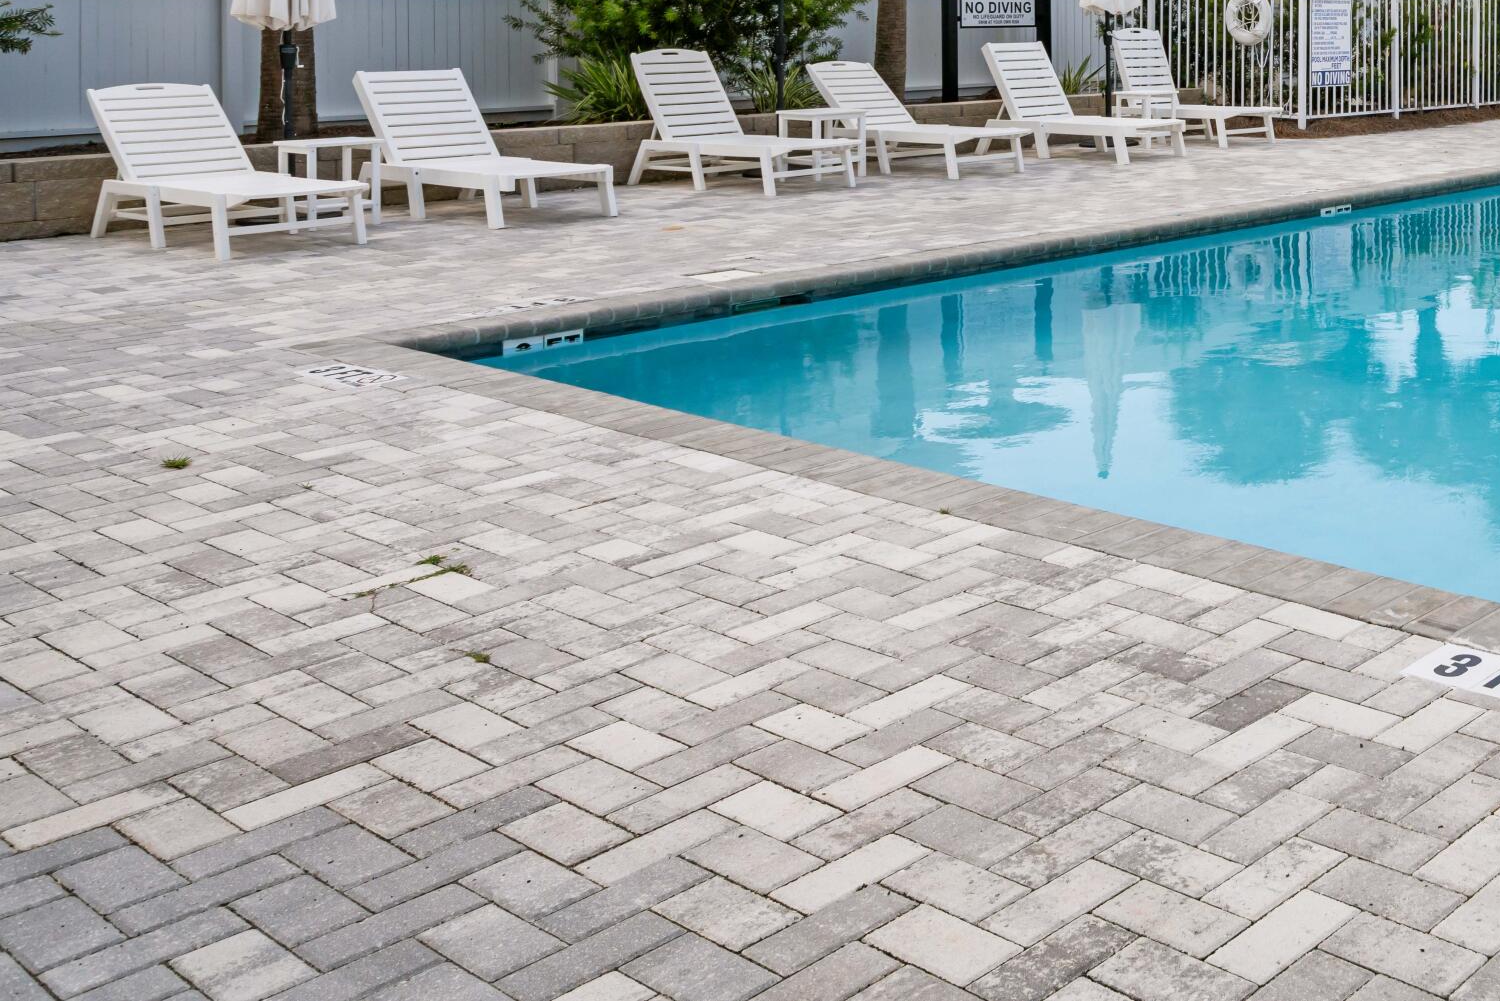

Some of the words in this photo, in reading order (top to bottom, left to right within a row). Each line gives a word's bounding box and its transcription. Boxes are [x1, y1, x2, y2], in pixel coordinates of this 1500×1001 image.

[965, 1, 984, 14] NO
[988, 1, 1032, 14] DIVING
[1312, 71, 1322, 86] NO
[1324, 70, 1351, 85] DIVING
[1433, 654, 1482, 678] 3
